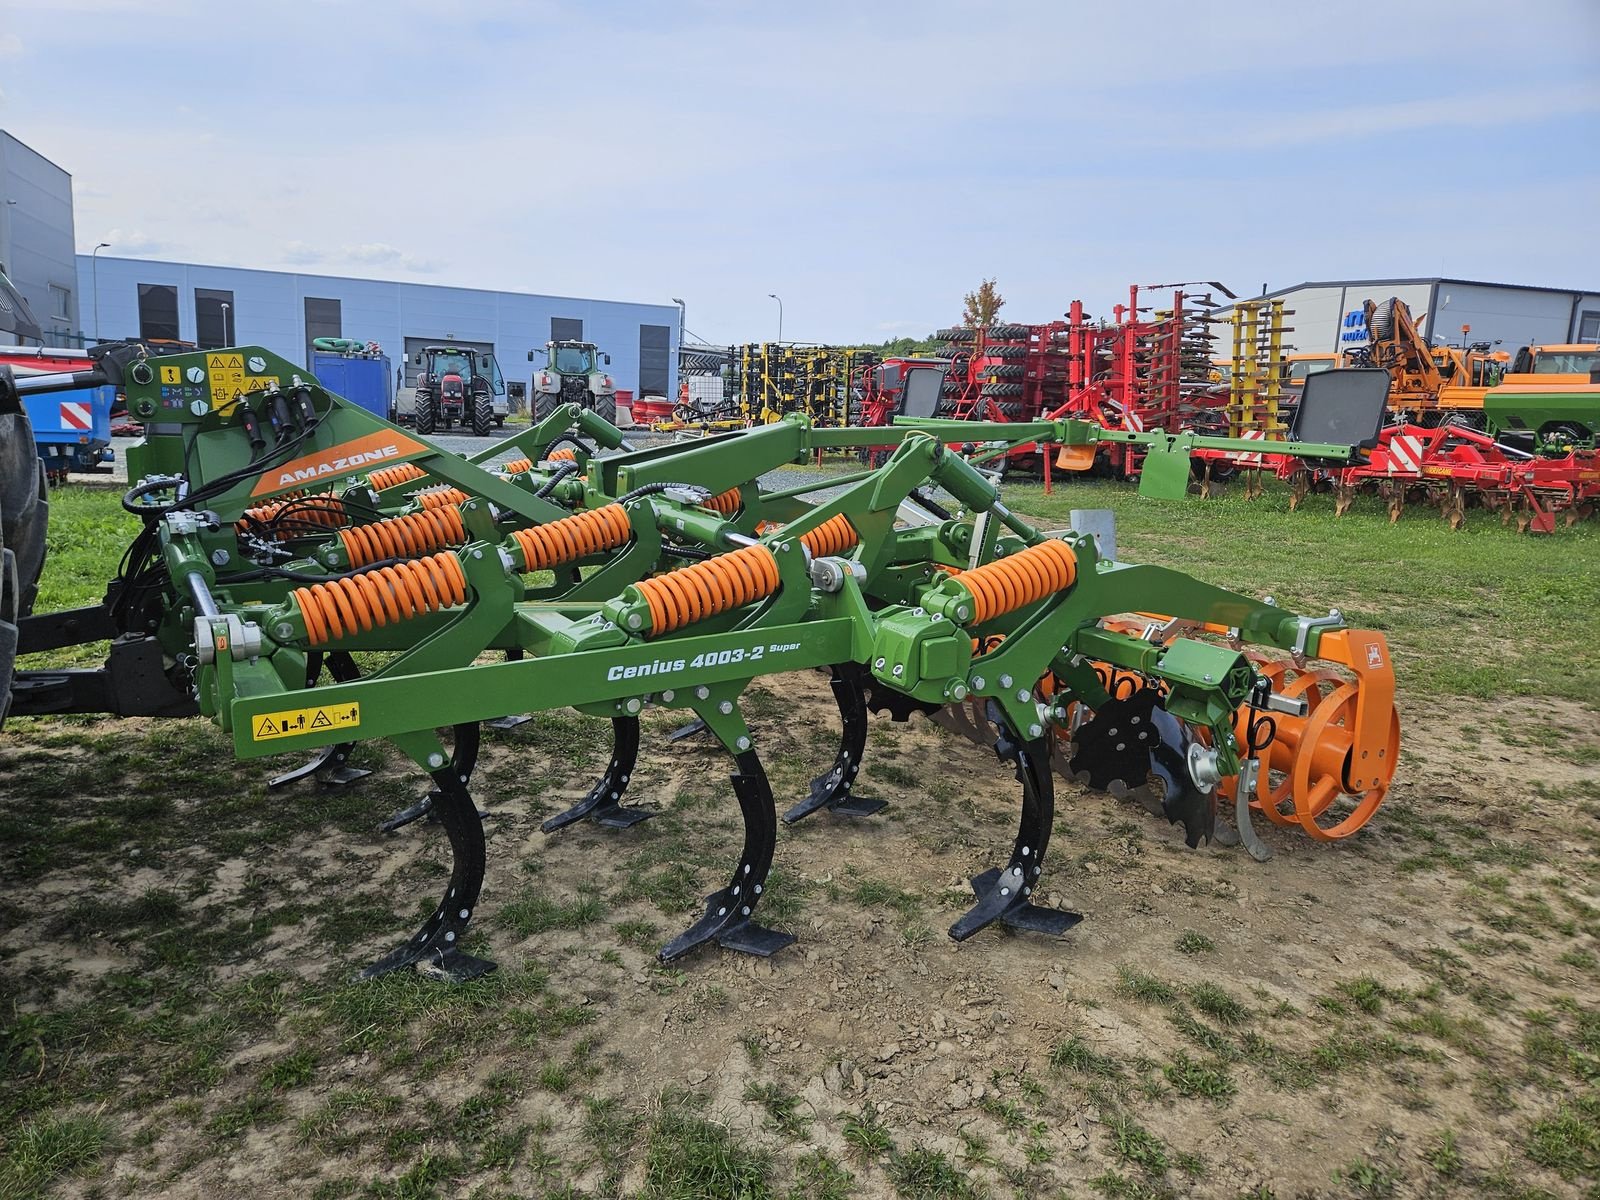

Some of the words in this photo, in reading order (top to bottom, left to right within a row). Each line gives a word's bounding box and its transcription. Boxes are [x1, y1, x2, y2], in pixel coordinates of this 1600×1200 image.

[279, 445, 399, 485] AMAZONE
[607, 659, 685, 681] Cenius
[690, 645, 765, 668] 4003-2
[769, 643, 801, 653] Super
